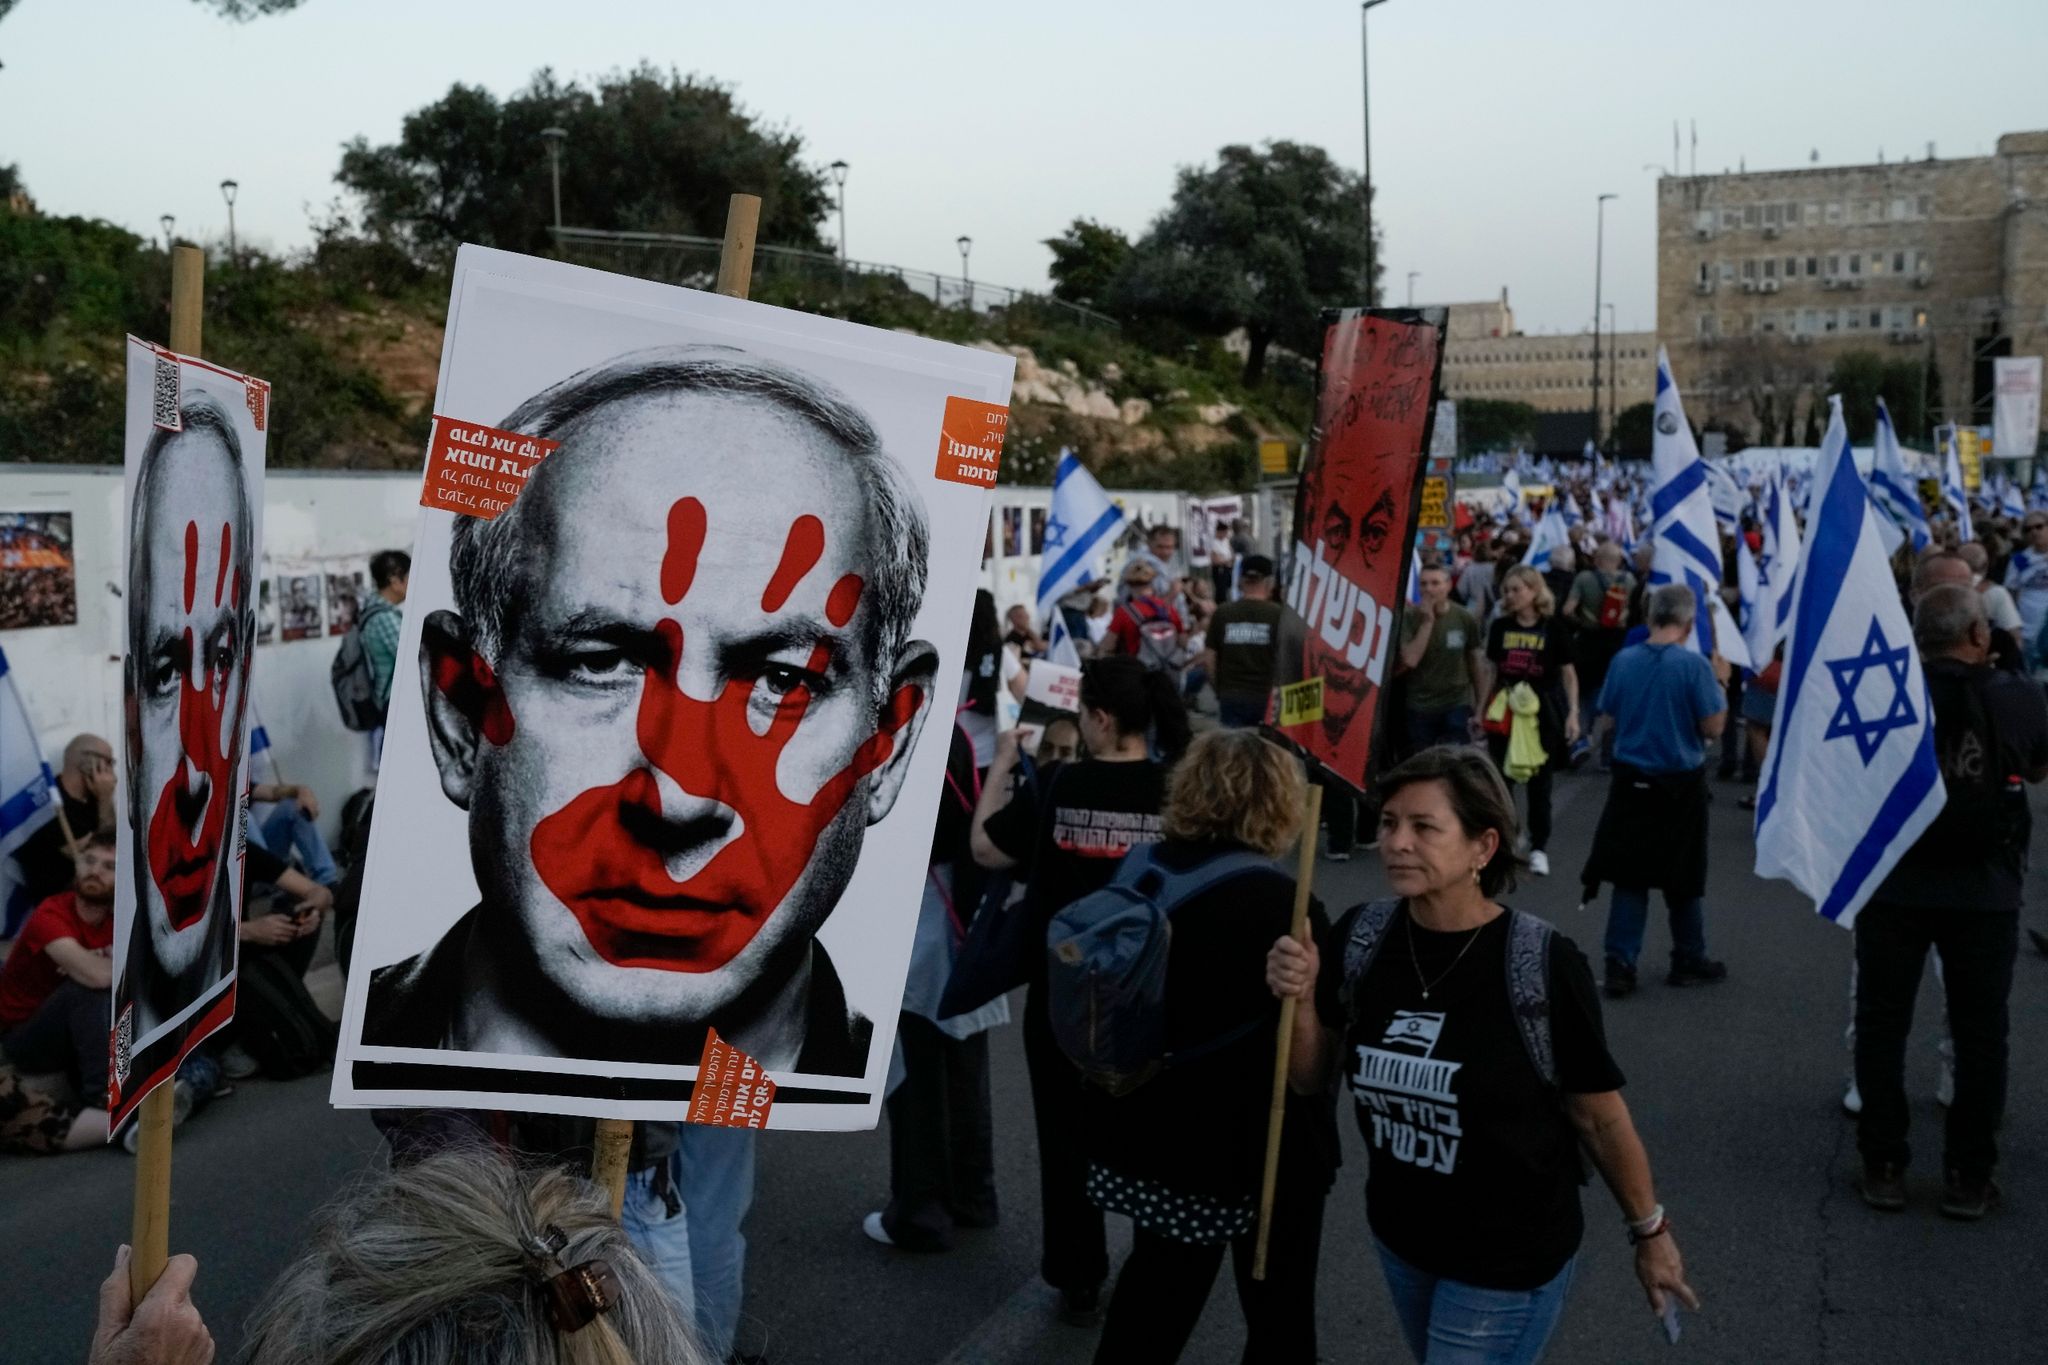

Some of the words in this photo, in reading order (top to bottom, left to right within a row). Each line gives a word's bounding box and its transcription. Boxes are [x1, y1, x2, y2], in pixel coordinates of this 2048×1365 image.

[449, 428, 488, 447] סרקו
[490, 436, 517, 453] את
[947, 440, 995, 463] איתנו!
[445, 446, 496, 471] אנחנו
[440, 469, 458, 484] על
[461, 473, 492, 490] עתיד
[958, 463, 998, 483] תרומה
[438, 487, 476, 509] בשביל
[1287, 538, 1393, 687] נכשלת
[702, 1048, 723, 1091] להמשיך
[730, 1083, 752, 1121] אותך
[1371, 1114, 1459, 1175] עכשיו
